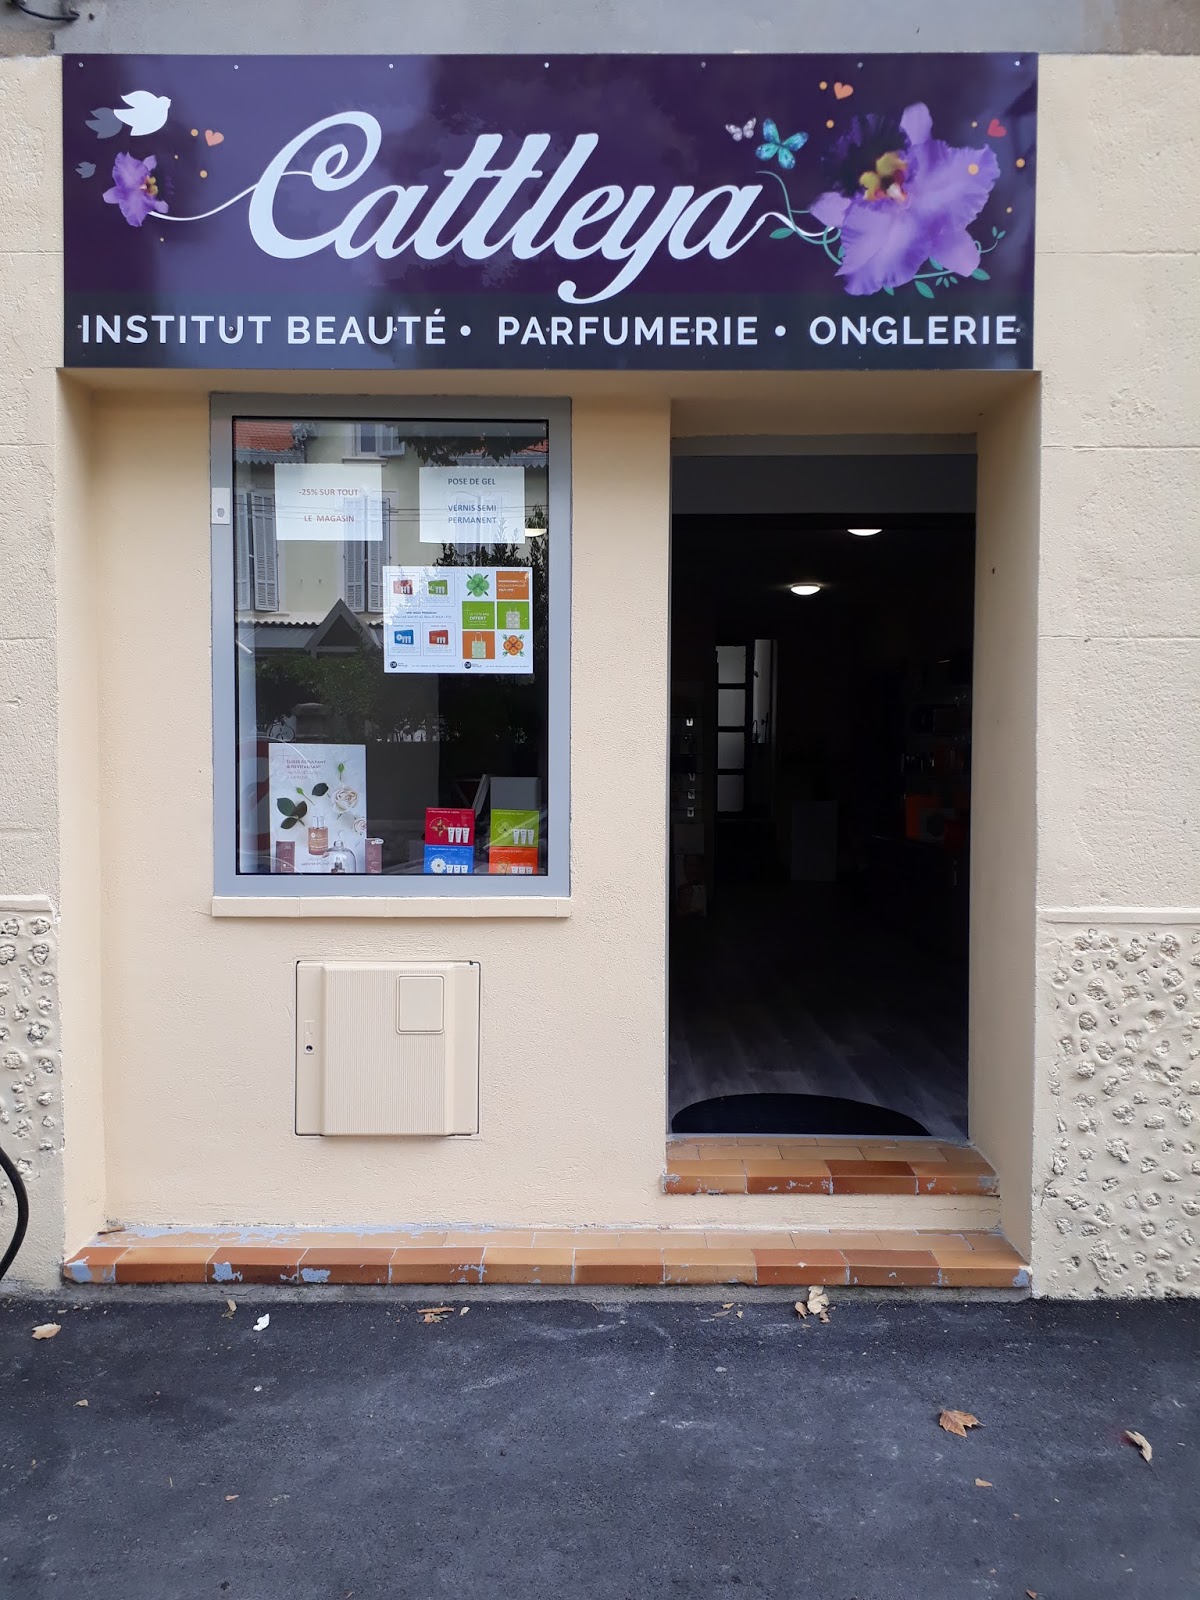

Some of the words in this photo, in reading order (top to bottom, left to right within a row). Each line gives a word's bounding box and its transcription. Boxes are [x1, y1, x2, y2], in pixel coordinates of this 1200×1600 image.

[248, 110, 765, 305] Cattleya
[82, 314, 272, 345] INSTITUT
[287, 308, 446, 346] BEAUTÉ
[498, 315, 758, 346] PARFUMERIE
[809, 315, 1017, 346] ONGLERIE
[447, 478, 468, 486] POSE
[469, 478, 480, 486] DE
[481, 478, 496, 486] GEL
[298, 488, 318, 496] -25%
[319, 488, 335, 496] SUR
[336, 488, 359, 496] TOUT
[447, 504, 476, 512] VERNIS
[477, 504, 497, 512] SEMI
[448, 516, 497, 524] PERMANENT
